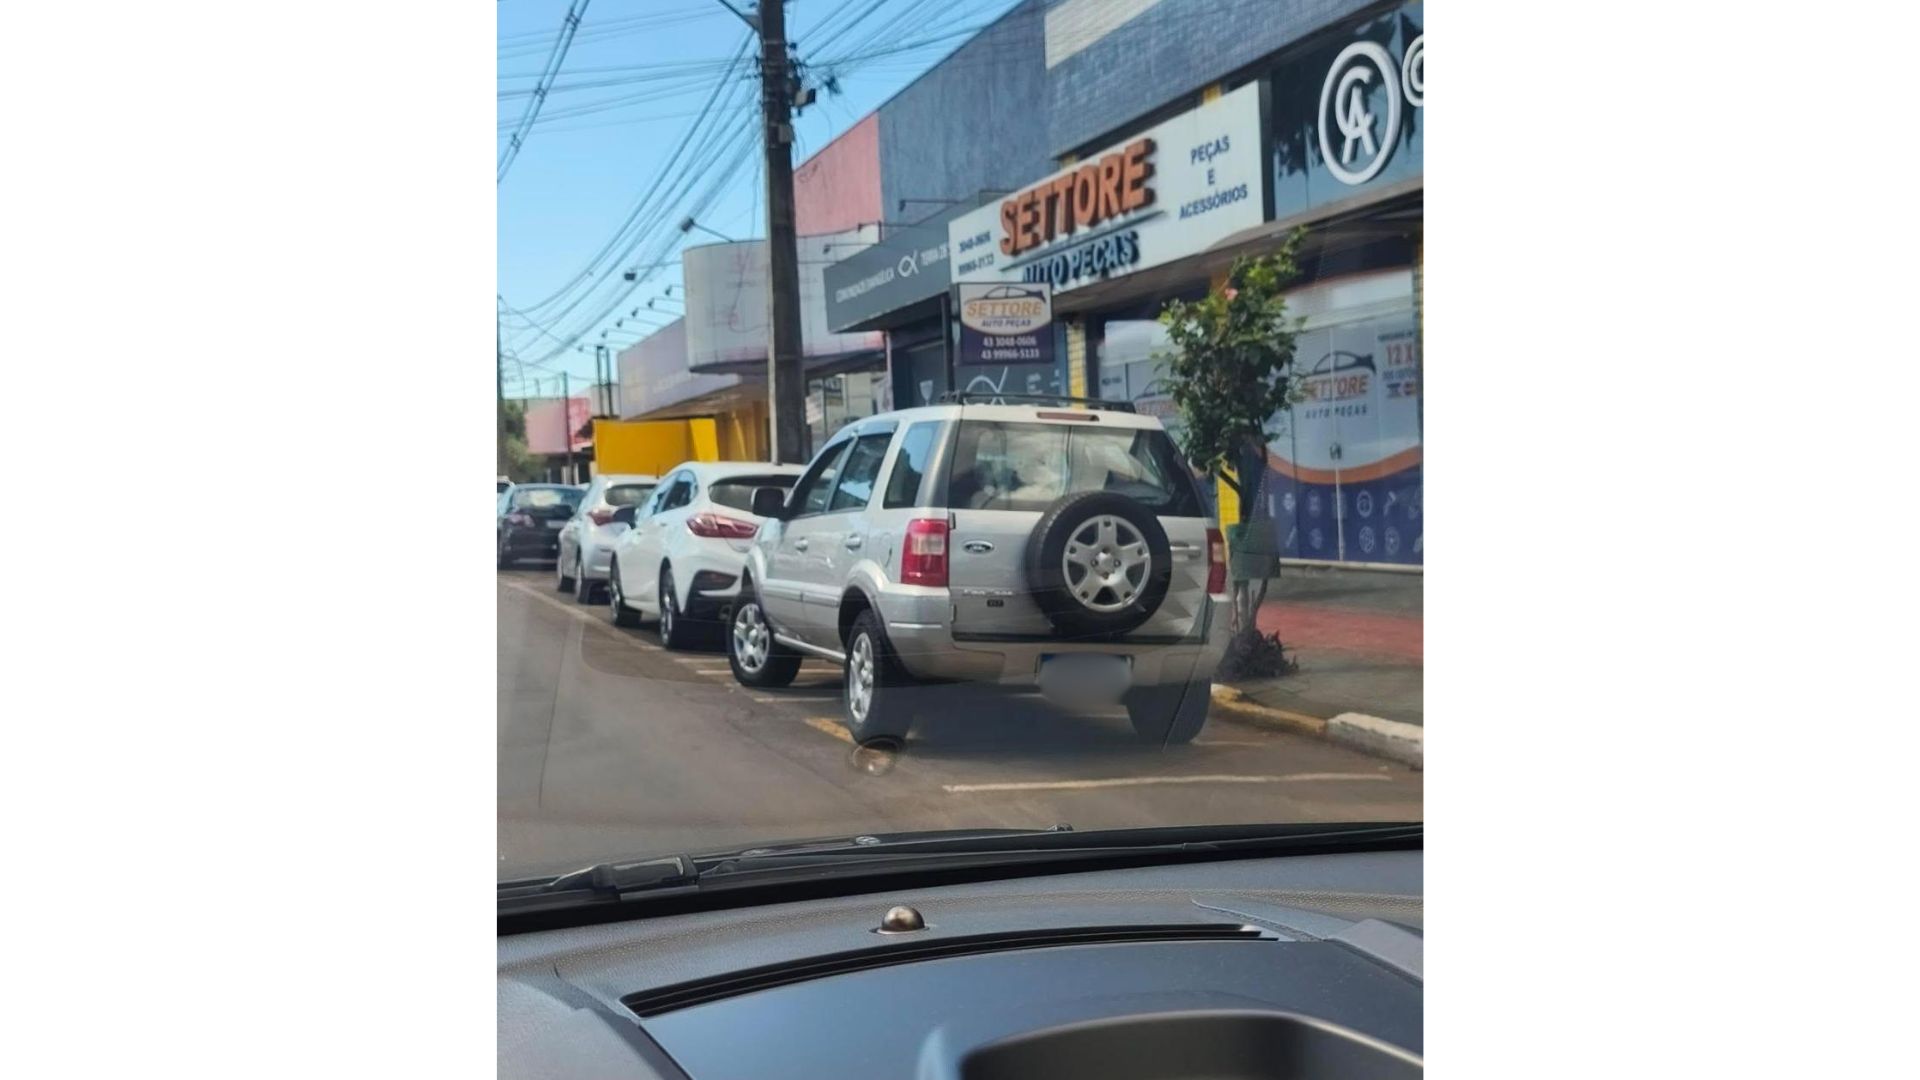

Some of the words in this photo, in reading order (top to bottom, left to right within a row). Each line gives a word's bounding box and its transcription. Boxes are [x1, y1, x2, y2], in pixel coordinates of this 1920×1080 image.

[1190, 135, 1230, 166] PEÇAS
[1207, 168, 1216, 186] E
[1000, 138, 1158, 256] SETTORE
[1180, 183, 1248, 219] ACESSÓRIOS
[1068, 231, 1139, 279] PEÇAS
[966, 301, 1042, 317] SETTORE
[981, 319, 1004, 328] AUTO
[1005, 318, 1031, 329] PEÇAS
[983, 337, 994, 348] 43
[981, 350, 993, 360] 43
